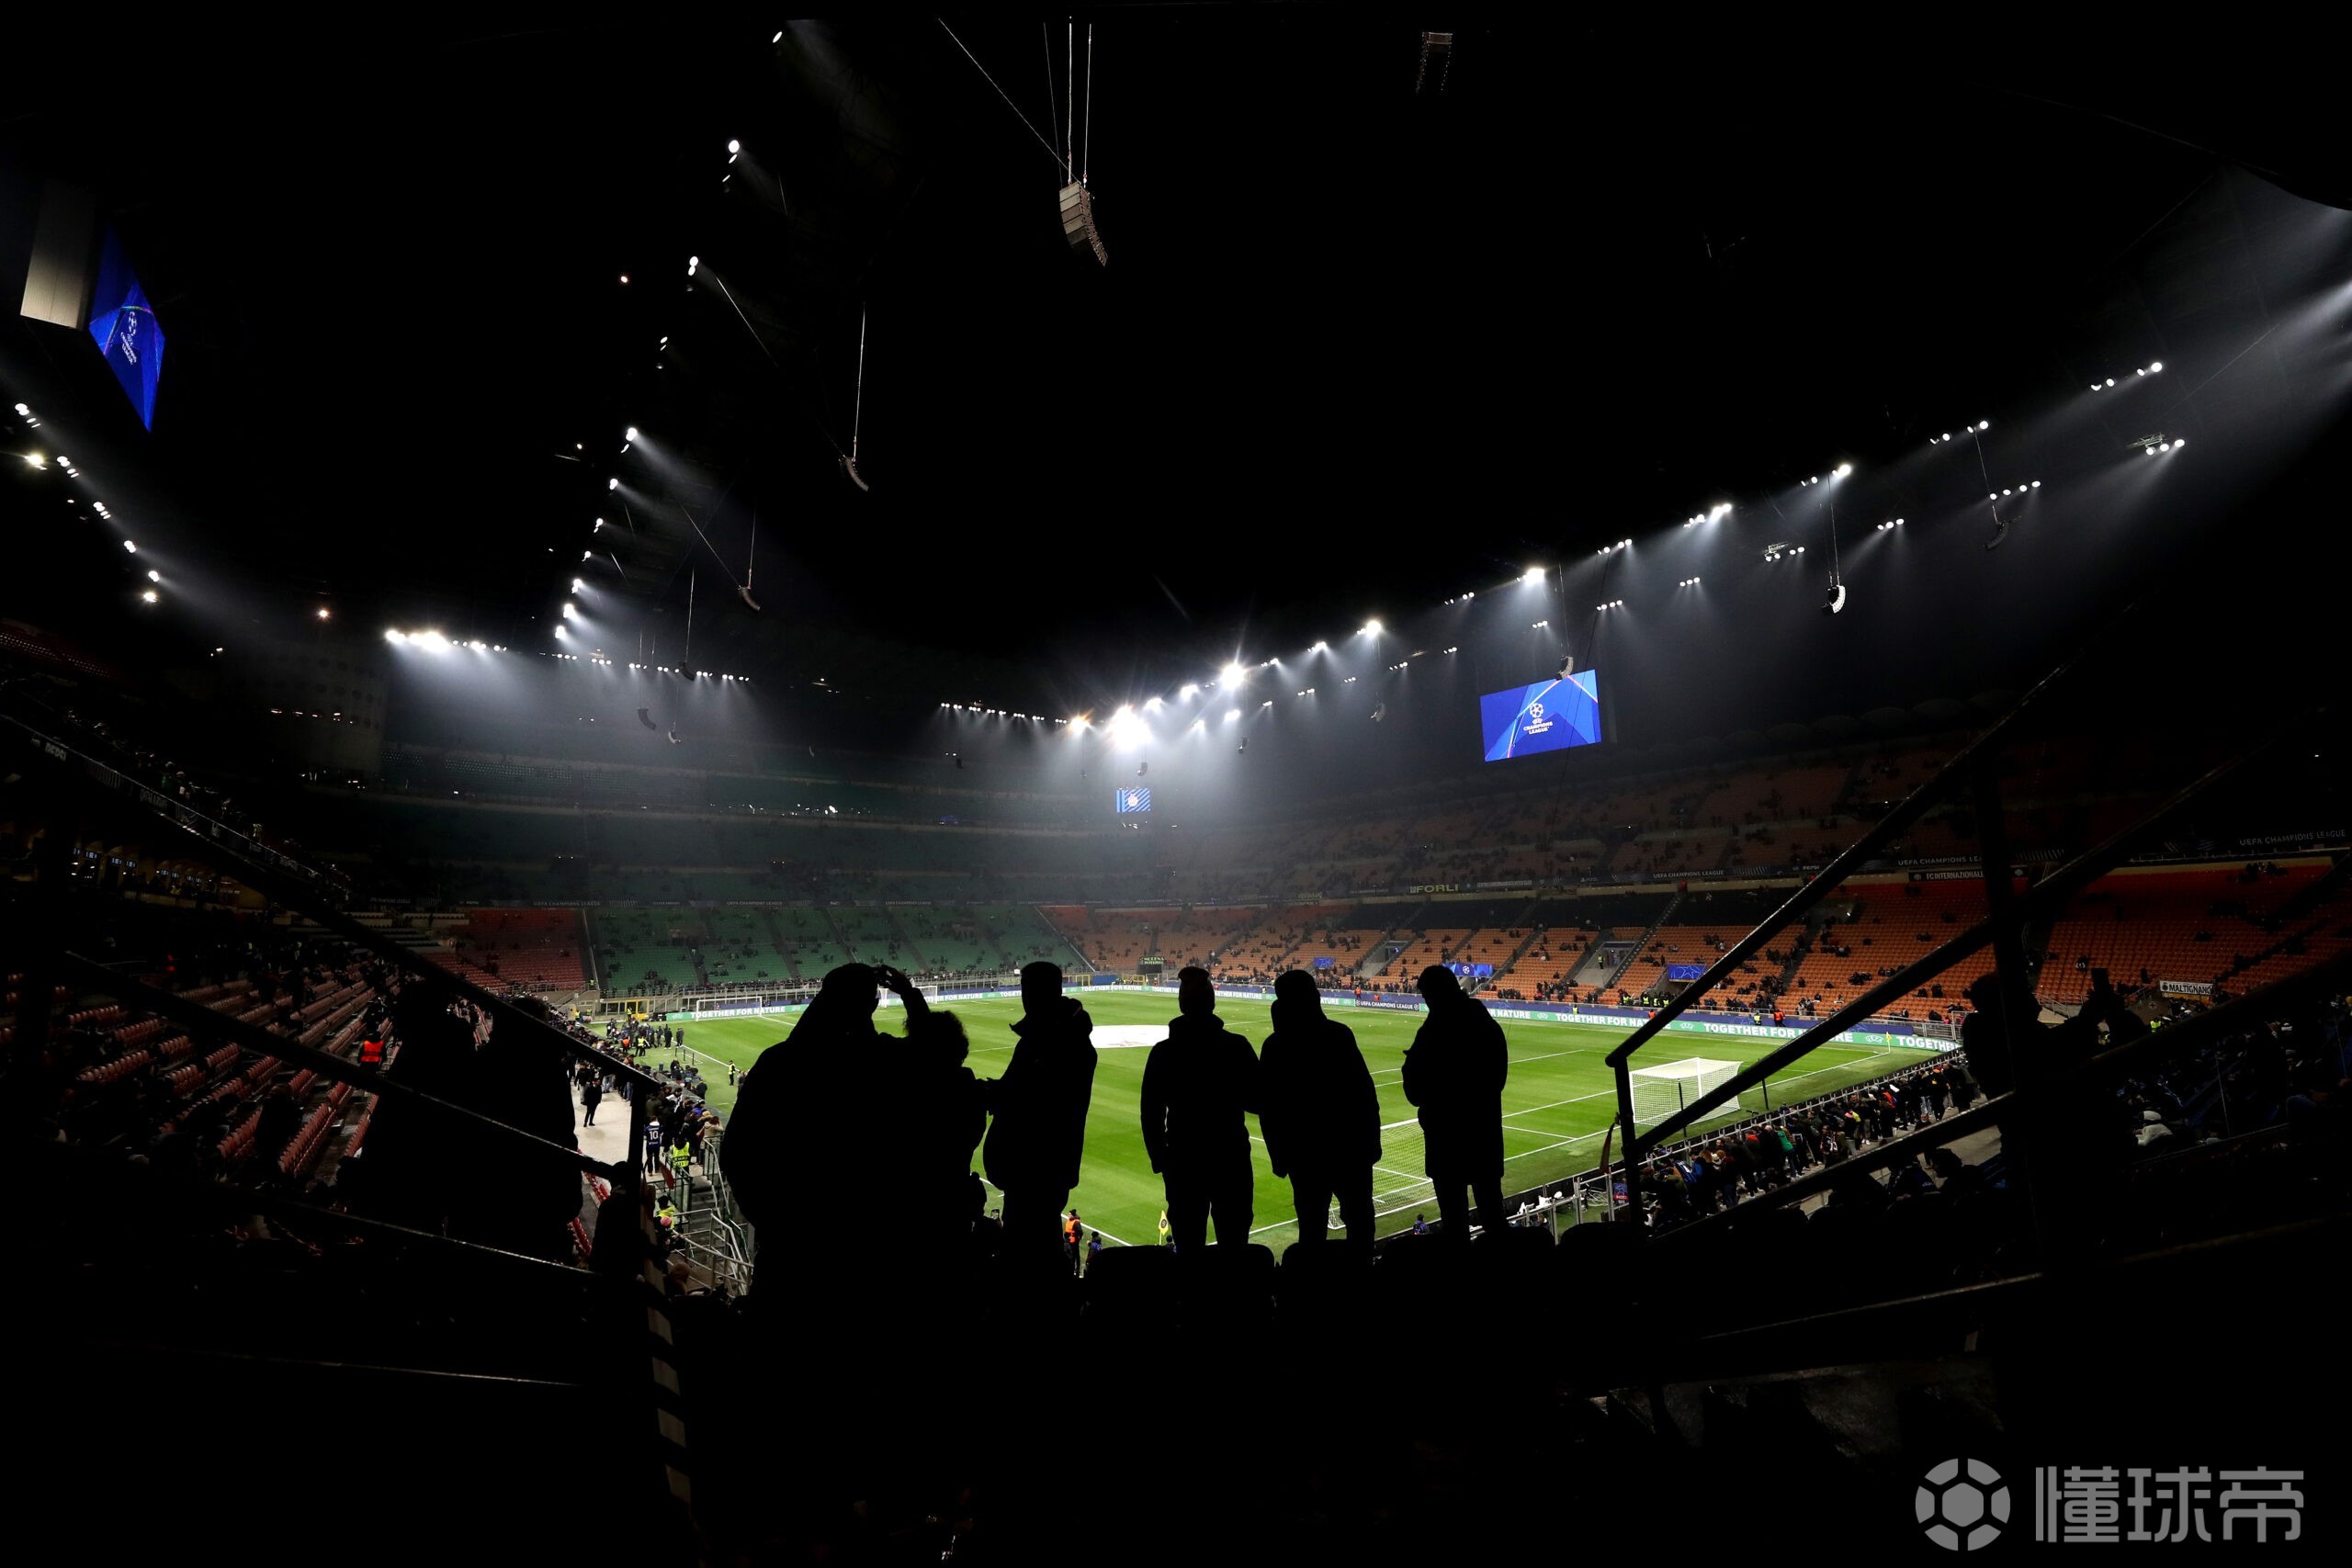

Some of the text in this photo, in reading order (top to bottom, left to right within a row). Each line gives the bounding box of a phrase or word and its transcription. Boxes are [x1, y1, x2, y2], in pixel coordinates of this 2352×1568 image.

[690, 1010, 735, 1019] TOGETHER
[753, 1007, 786, 1015] NATURE
[1497, 1010, 1531, 1020] NATURE
[1555, 1013, 1608, 1024] TOGETHER
[1608, 1017, 1627, 1026] FOR
[1703, 1022, 1768, 1037] TOGETHER
[1770, 1027, 1796, 1038] FOR
[649, 1130, 659, 1140] 10
